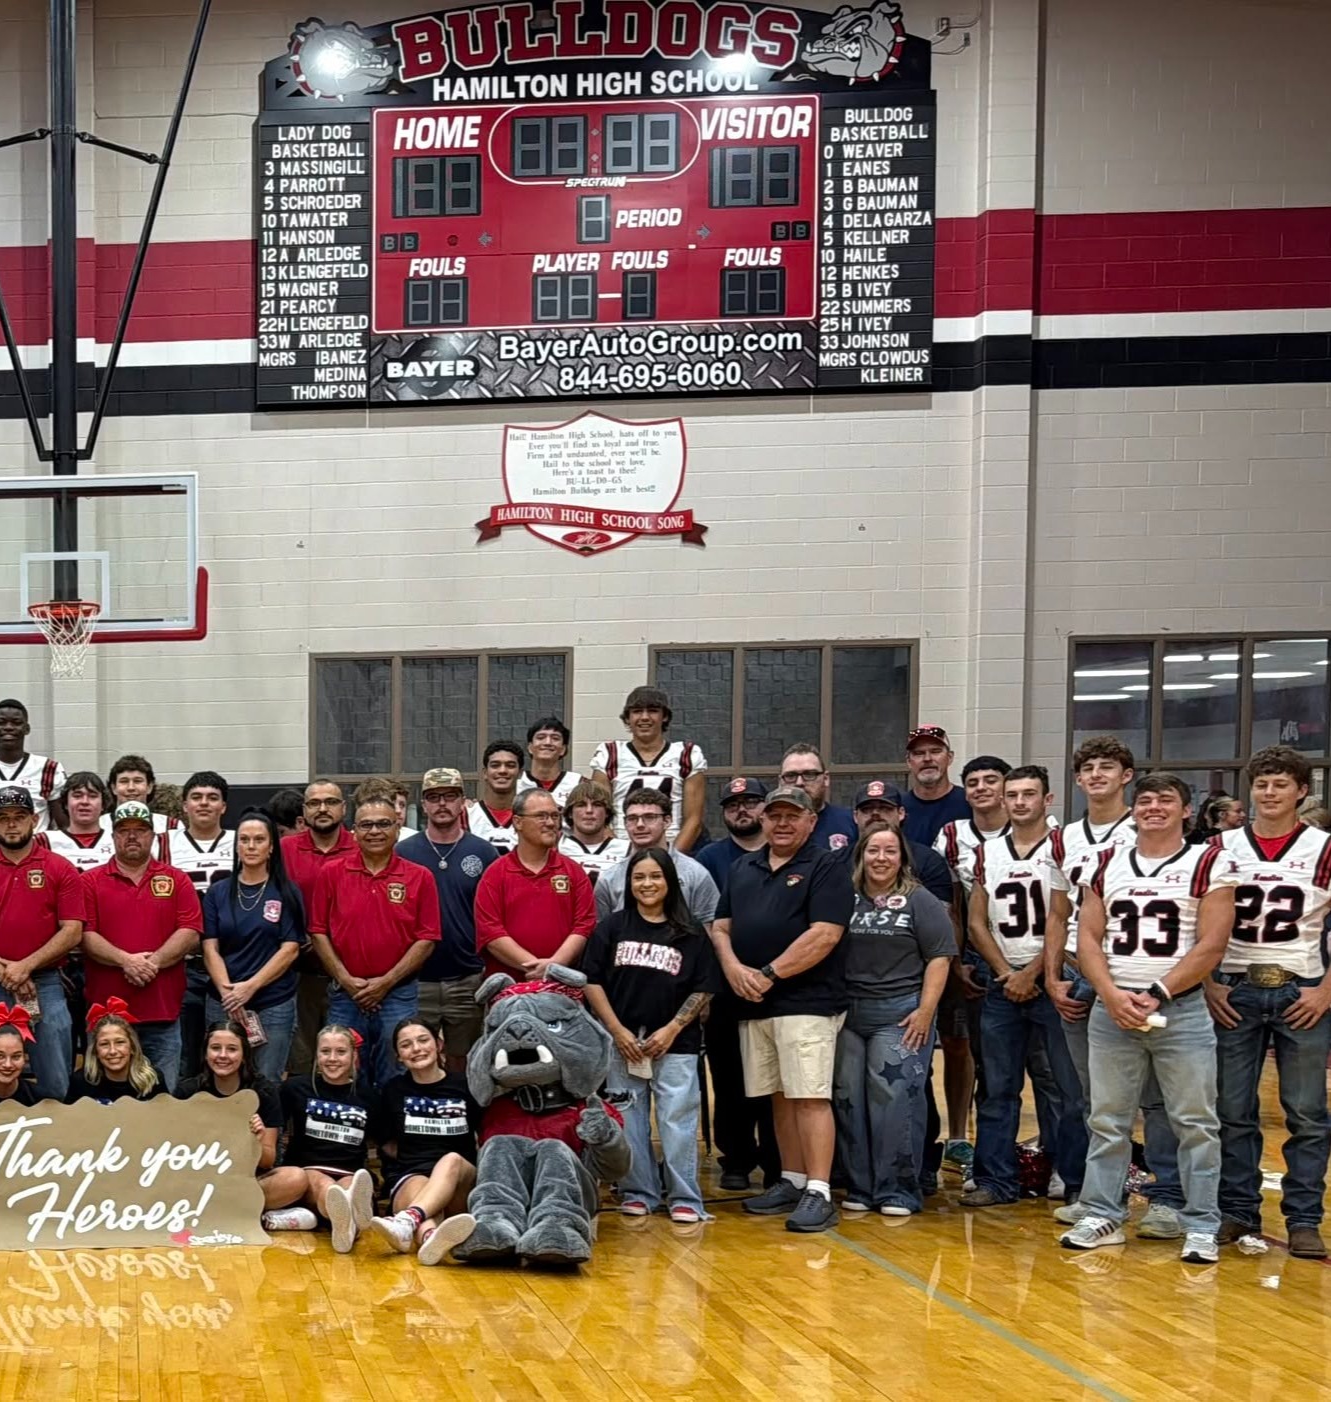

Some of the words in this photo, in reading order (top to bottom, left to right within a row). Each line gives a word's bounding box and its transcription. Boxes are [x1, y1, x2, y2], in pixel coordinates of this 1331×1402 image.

[391, 0, 802, 83] BULLDOGS
[433, 74, 568, 102] HAMILTON
[576, 72, 642, 96] HIGH
[650, 68, 759, 94] SCHOOL
[699, 105, 813, 141] VISITOR
[845, 107, 913, 123] BULLDOG
[278, 126, 315, 140] LADY
[322, 125, 351, 140] DOG
[393, 116, 482, 150] HOME
[831, 124, 928, 142] BASKETBALL
[272, 142, 364, 158] BASKETBALL
[824, 145, 833, 159] 0
[843, 143, 903, 158] WEAVER
[265, 161, 274, 175] 3
[280, 160, 365, 175] MASSINGILL
[827, 163, 832, 177] 1
[843, 161, 890, 176] EANES
[264, 179, 274, 193] 4
[280, 177, 345, 193] PARROTT
[824, 179, 834, 194] 2
[843, 180, 853, 193] B
[858, 177, 919, 193] BAUMAN
[264, 196, 274, 210] 5
[280, 194, 361, 210] SCHROEDER
[824, 197, 833, 211] 3
[843, 197, 853, 211] G
[857, 194, 918, 210] BAUMAN
[262, 214, 277, 228] 10
[280, 212, 348, 227] TAWATER
[615, 208, 682, 228] PERIOD
[823, 214, 833, 228] 4
[263, 231, 273, 245] 11
[279, 229, 335, 245] HANSON
[824, 231, 833, 246] 5
[844, 229, 909, 245] KELLNER
[262, 248, 277, 262] 12
[297, 246, 361, 262] ARLEDGE
[532, 253, 600, 273] PLAYER
[611, 250, 668, 271] FOULS
[724, 247, 782, 267] FOULS
[821, 249, 835, 263] 10
[844, 248, 887, 262] HAILE
[262, 266, 276, 280] 13
[408, 256, 466, 277] FOULS
[821, 266, 837, 280] 12
[842, 264, 899, 280] HENKES
[262, 283, 275, 297] 15
[278, 281, 338, 297] WAGNER
[821, 283, 836, 298] 15
[842, 283, 852, 297] B
[858, 282, 892, 297] IVEY
[260, 300, 274, 314] 21
[280, 298, 336, 314] PEARCY
[821, 301, 840, 315] 22
[843, 299, 911, 314] SUMMERS
[291, 315, 368, 331] LENGEFELD
[859, 316, 892, 331] IVEY
[299, 333, 362, 348] ARLEDGE
[499, 329, 803, 364] BayerAutoGroup.com
[820, 335, 838, 349] 33
[842, 333, 909, 348] JOHNSON
[259, 352, 296, 367] MGRS
[316, 350, 366, 365] IBANEZ
[819, 352, 857, 367] MGRS
[860, 350, 929, 365] CLOWDUS
[314, 367, 367, 382] MEDINA
[386, 360, 474, 378] BAYER
[559, 361, 742, 392] 844-695-6060
[861, 367, 923, 383] KLEINER
[291, 384, 366, 400] THOMPSON
[531, 432, 564, 440] Hamilton
[569, 432, 585, 440] High
[497, 506, 554, 520] HAMILTON
[560, 509, 594, 524] HIGH
[602, 513, 652, 529] SCHOOL
[657, 515, 684, 529] SONG
[995, 880, 1045, 938] 31
[1232, 885, 1305, 943] 22
[1110, 900, 1180, 957] 33
[139, 1140, 232, 1187] you,
[7, 1171, 214, 1243] Heroes!
